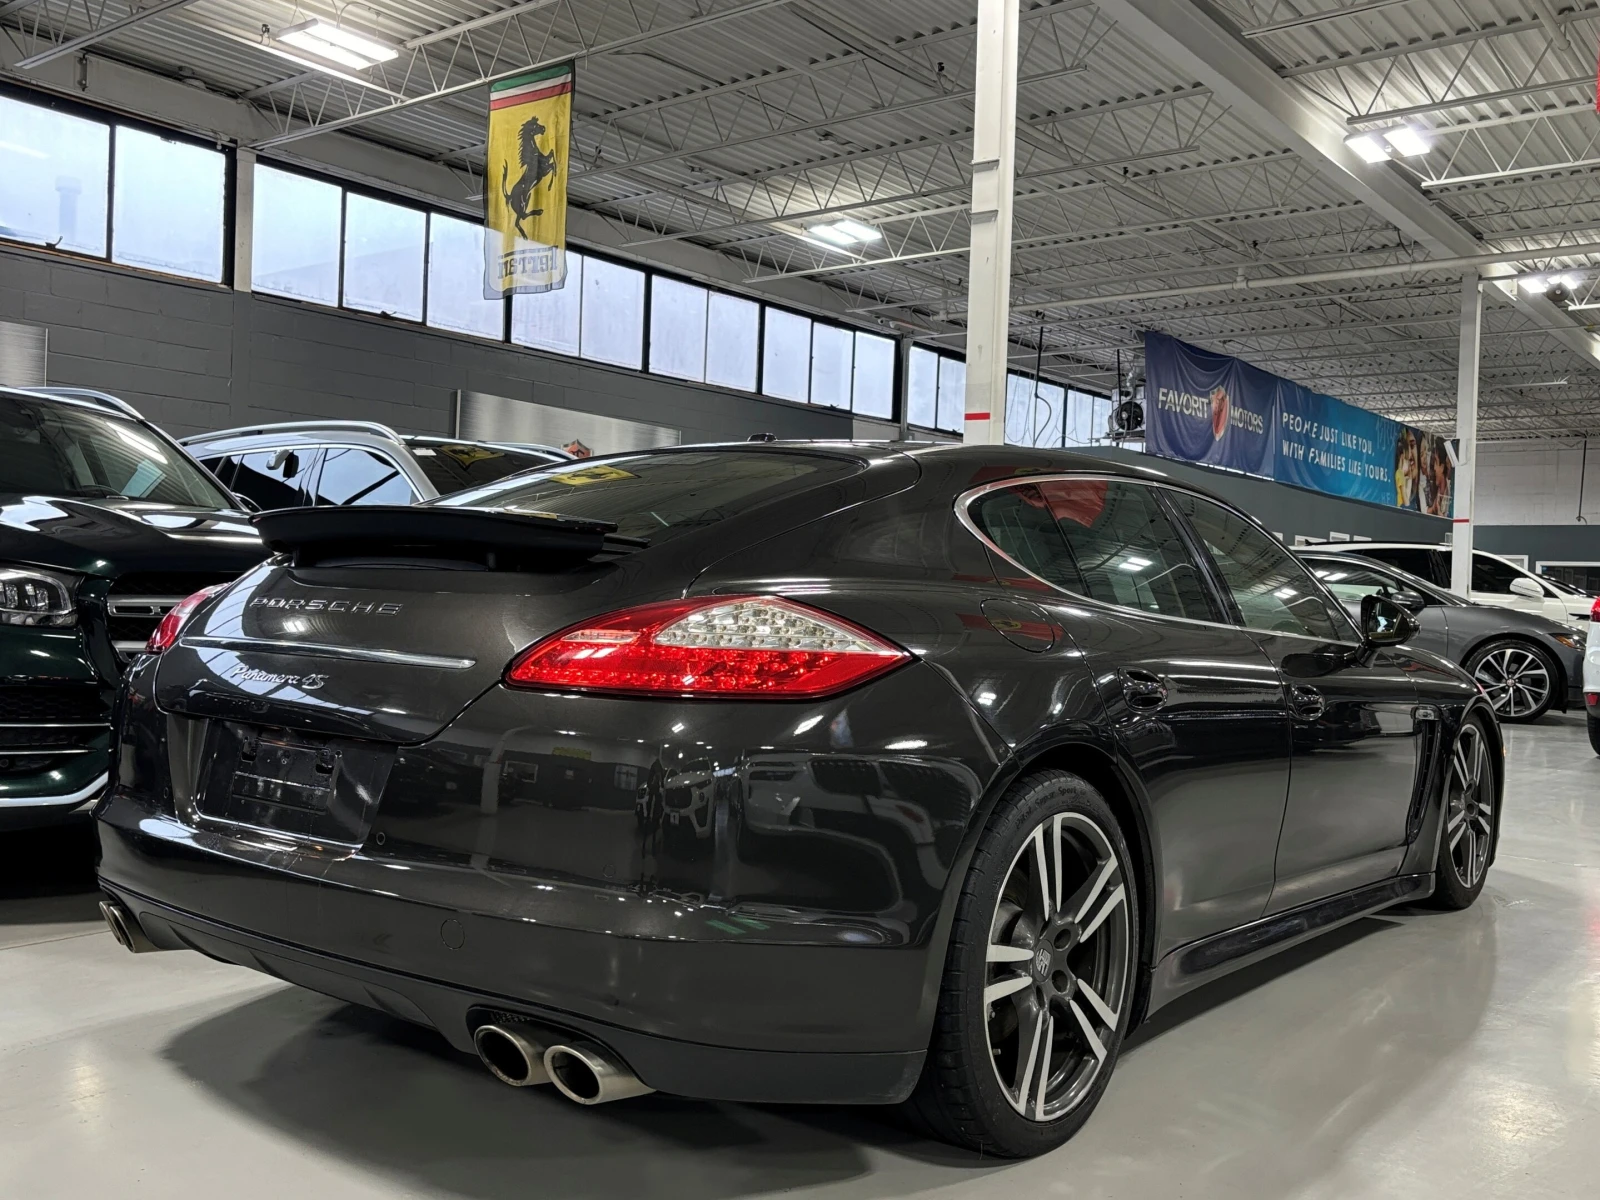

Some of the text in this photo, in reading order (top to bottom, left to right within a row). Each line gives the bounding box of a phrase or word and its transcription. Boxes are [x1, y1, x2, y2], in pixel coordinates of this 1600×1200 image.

[1158, 387, 1264, 435] FAVORIT MOTORS
[1319, 425, 1338, 445] JUST
[1341, 431, 1357, 450] LIKE
[1358, 437, 1375, 457] YOU,
[1282, 439, 1391, 483] WITH FAMILIES LIKE YOURS.
[249, 597, 403, 615] PORSCHE
[231, 666, 329, 690] Panamera 4S
[1058, 786, 1077, 795] Sport
